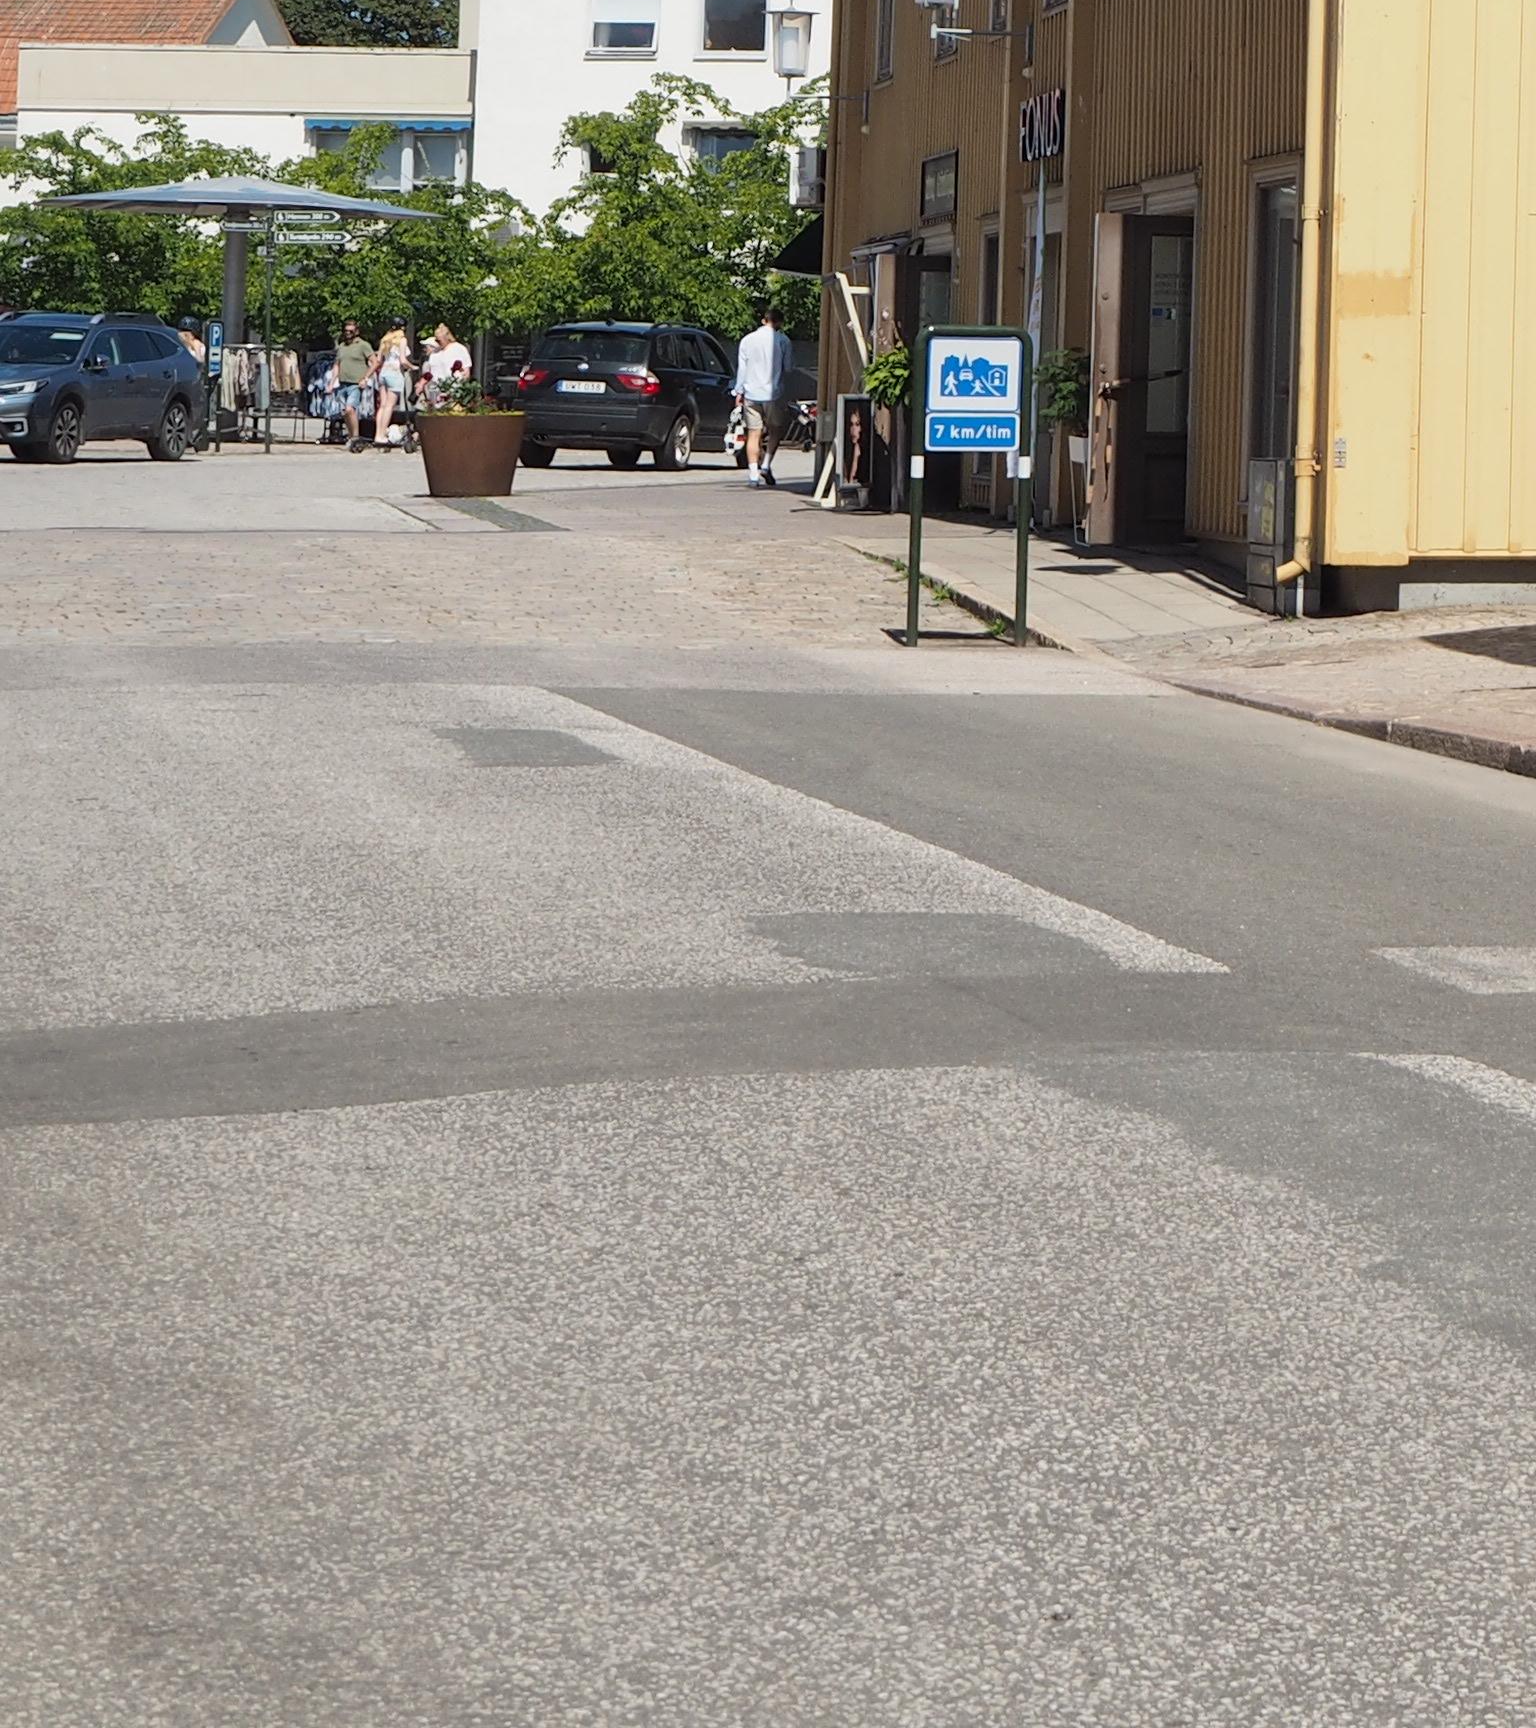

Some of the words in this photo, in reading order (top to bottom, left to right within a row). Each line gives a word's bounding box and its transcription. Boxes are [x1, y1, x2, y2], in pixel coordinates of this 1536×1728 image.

[1019, 88, 1061, 163] FONUS
[213, 326, 220, 346] P
[934, 424, 945, 439] 7
[950, 424, 1011, 439] km/tim
